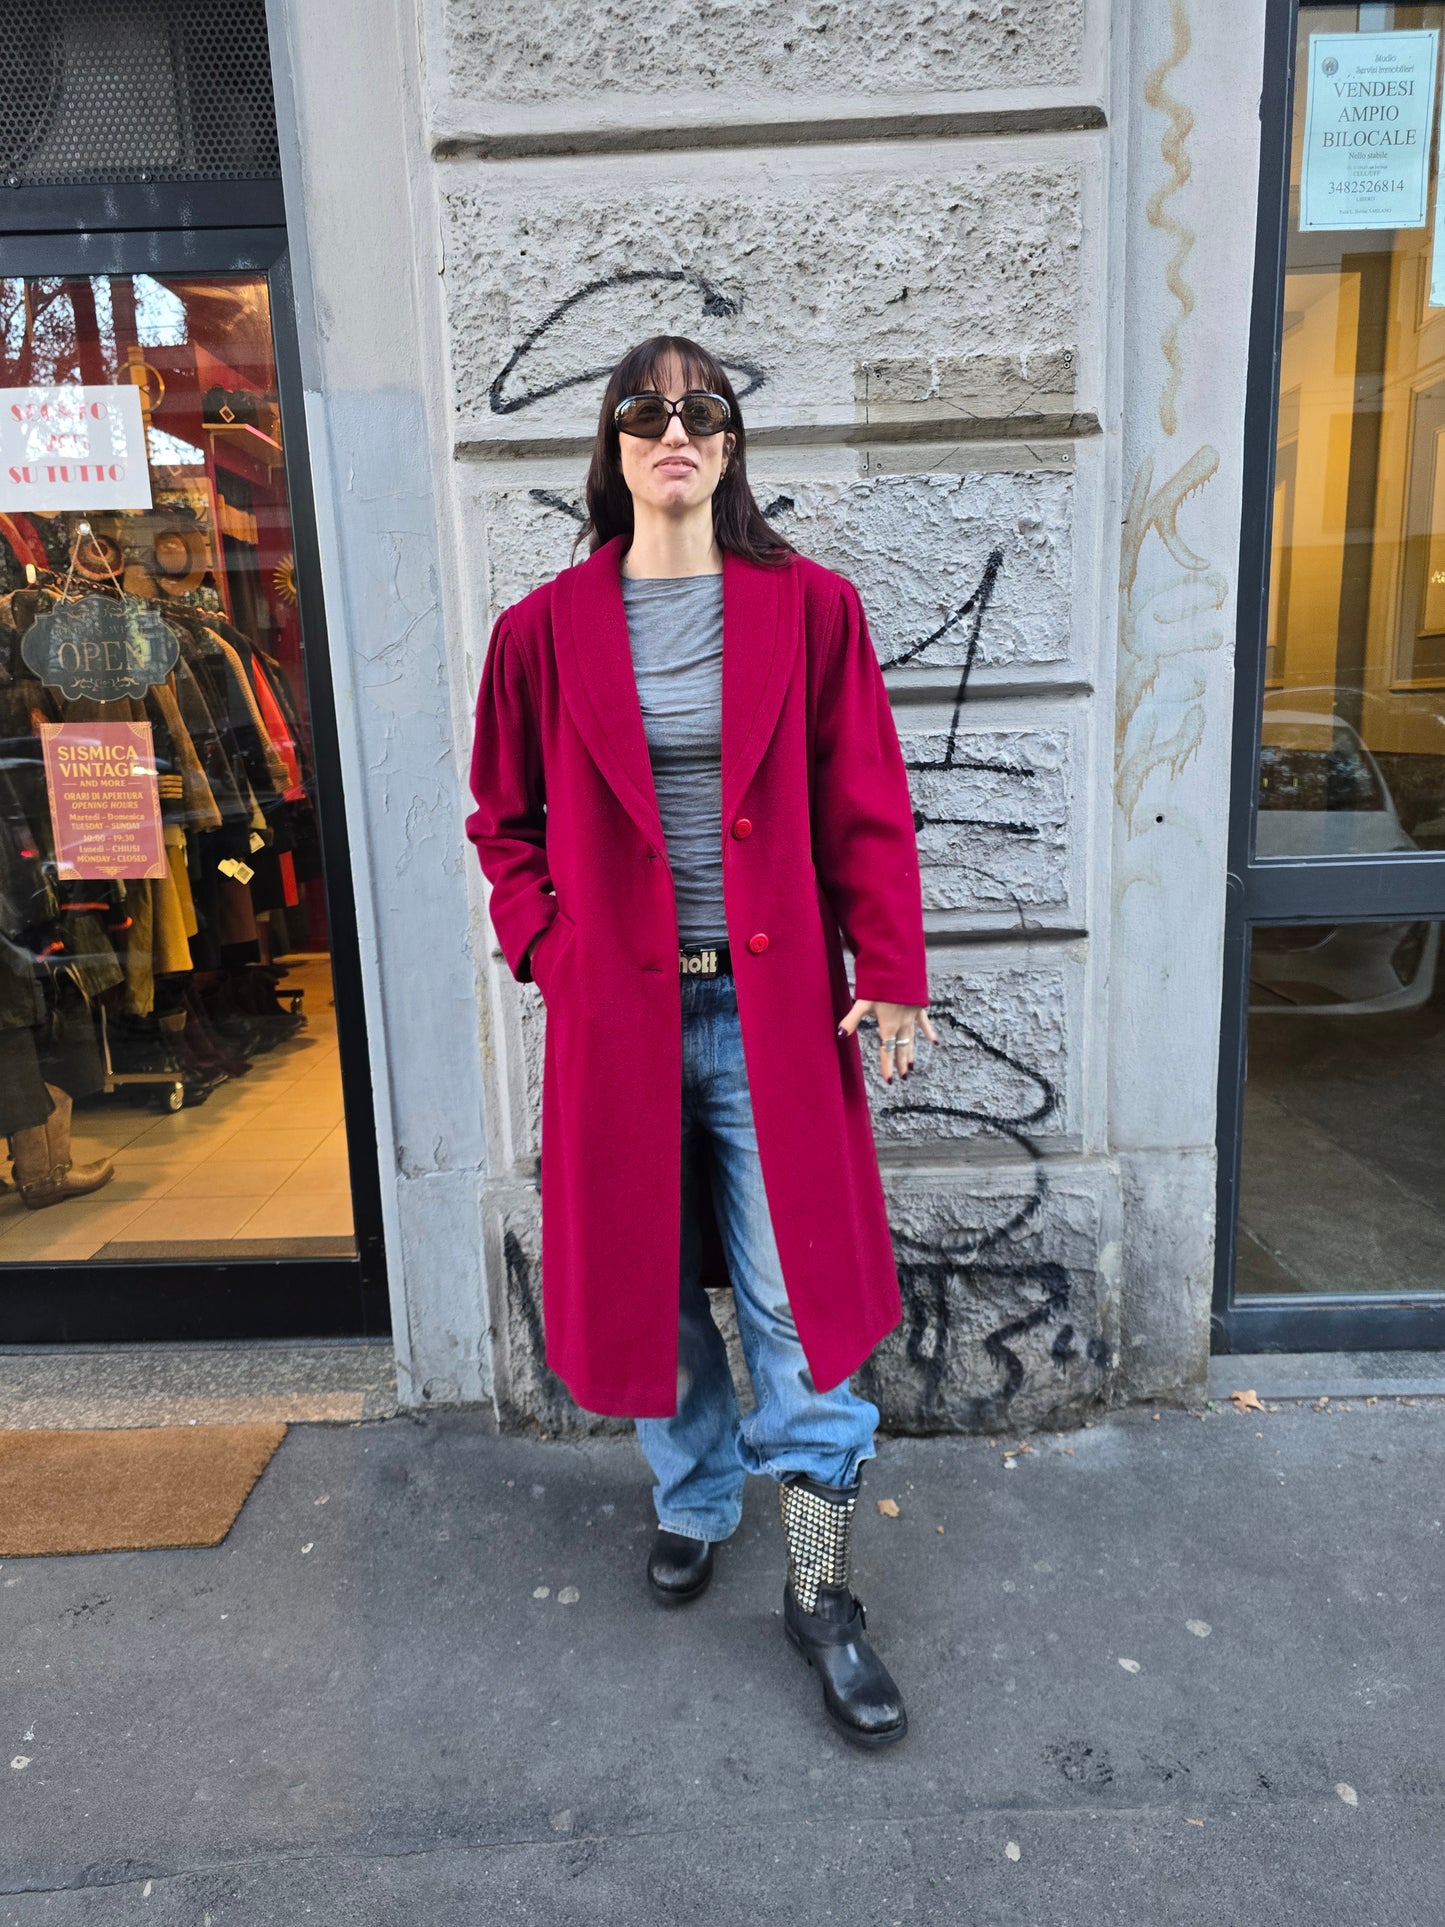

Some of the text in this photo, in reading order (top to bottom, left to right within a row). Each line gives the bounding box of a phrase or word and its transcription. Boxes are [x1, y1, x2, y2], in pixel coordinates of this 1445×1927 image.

[1375, 54, 1397, 63] Studio
[1333, 80, 1415, 98] VENDESI
[1338, 105, 1399, 123] AMPIO
[1322, 129, 1417, 148] BILOCALE
[1328, 179, 1405, 195] 3482526814
[8, 464, 126, 484] SU TUTTO
[57, 640, 146, 672] OPEN
[57, 745, 139, 761] SISMICA
[59, 762, 143, 778] VINTAGE
[79, 779, 127, 788] AND MORE
[64, 791, 144, 800] ORARI DI APERTURA
[71, 800, 139, 810] OPENING HOURS
[107, 812, 145, 821] Domenica
[72, 822, 104, 831] TUESDAY
[111, 822, 141, 830] SUNDAY
[113, 834, 135, 842] 19:30
[77, 855, 111, 863] MONDAY
[117, 854, 148, 863] CLOSED
